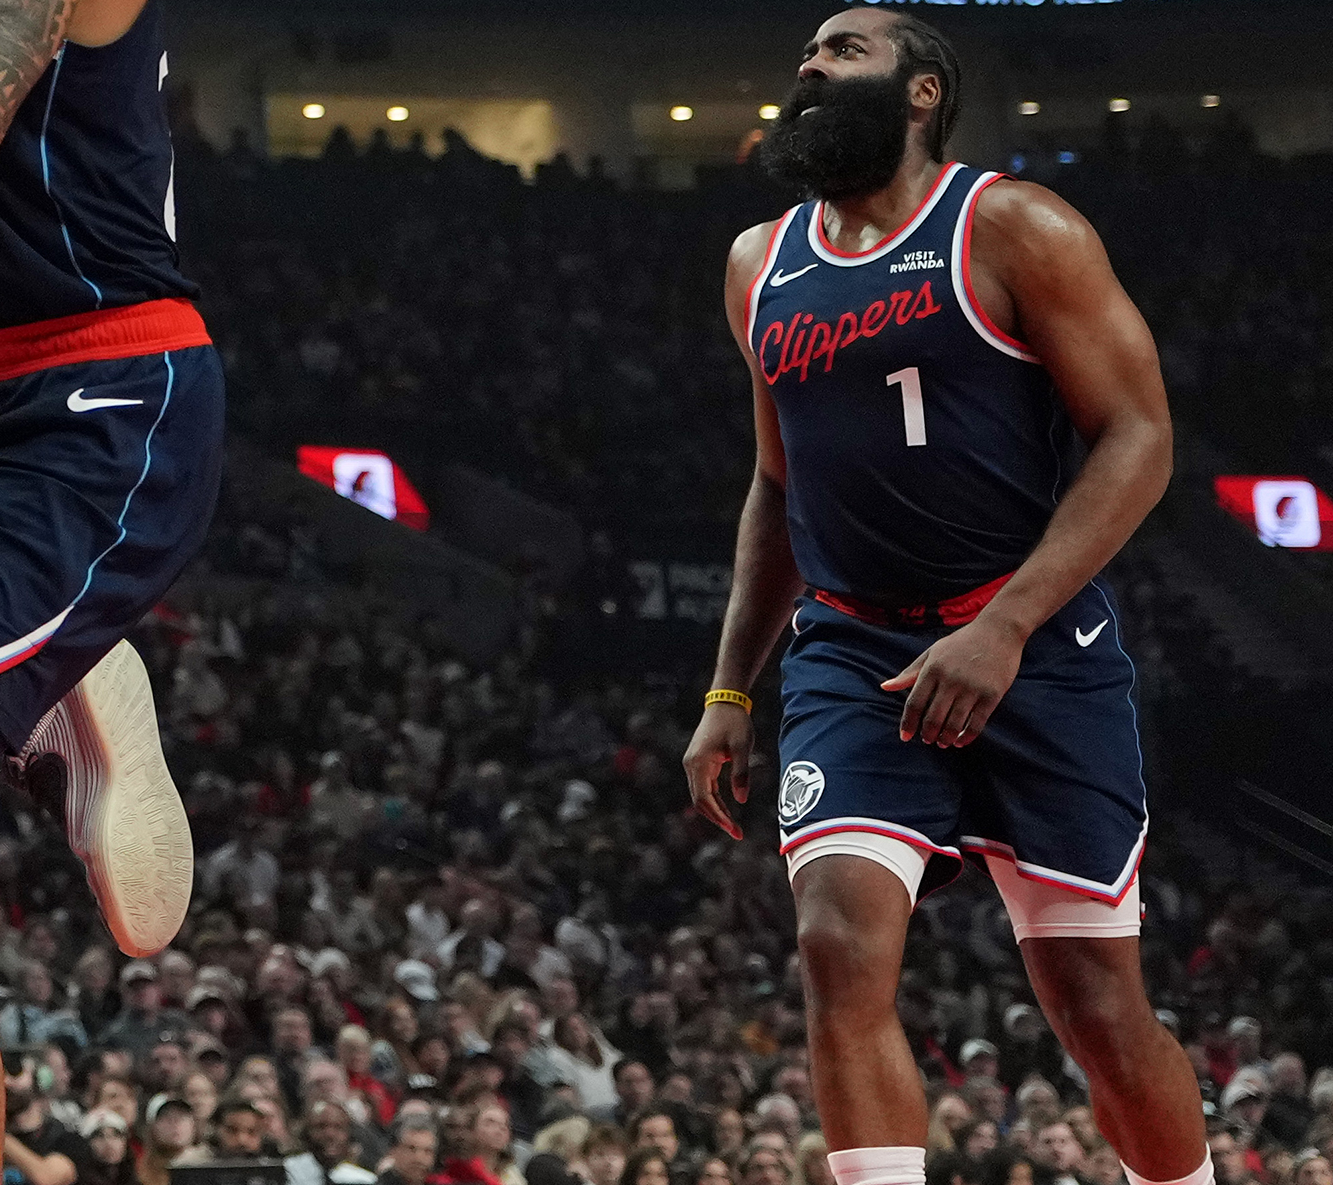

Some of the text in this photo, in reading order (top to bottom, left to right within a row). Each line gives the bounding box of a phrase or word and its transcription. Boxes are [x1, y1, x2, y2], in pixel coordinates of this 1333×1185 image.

[889, 258, 945, 274] RWANDA
[903, 250, 936, 263] VISIT
[759, 281, 942, 385] Clippers
[886, 366, 927, 447] 1
